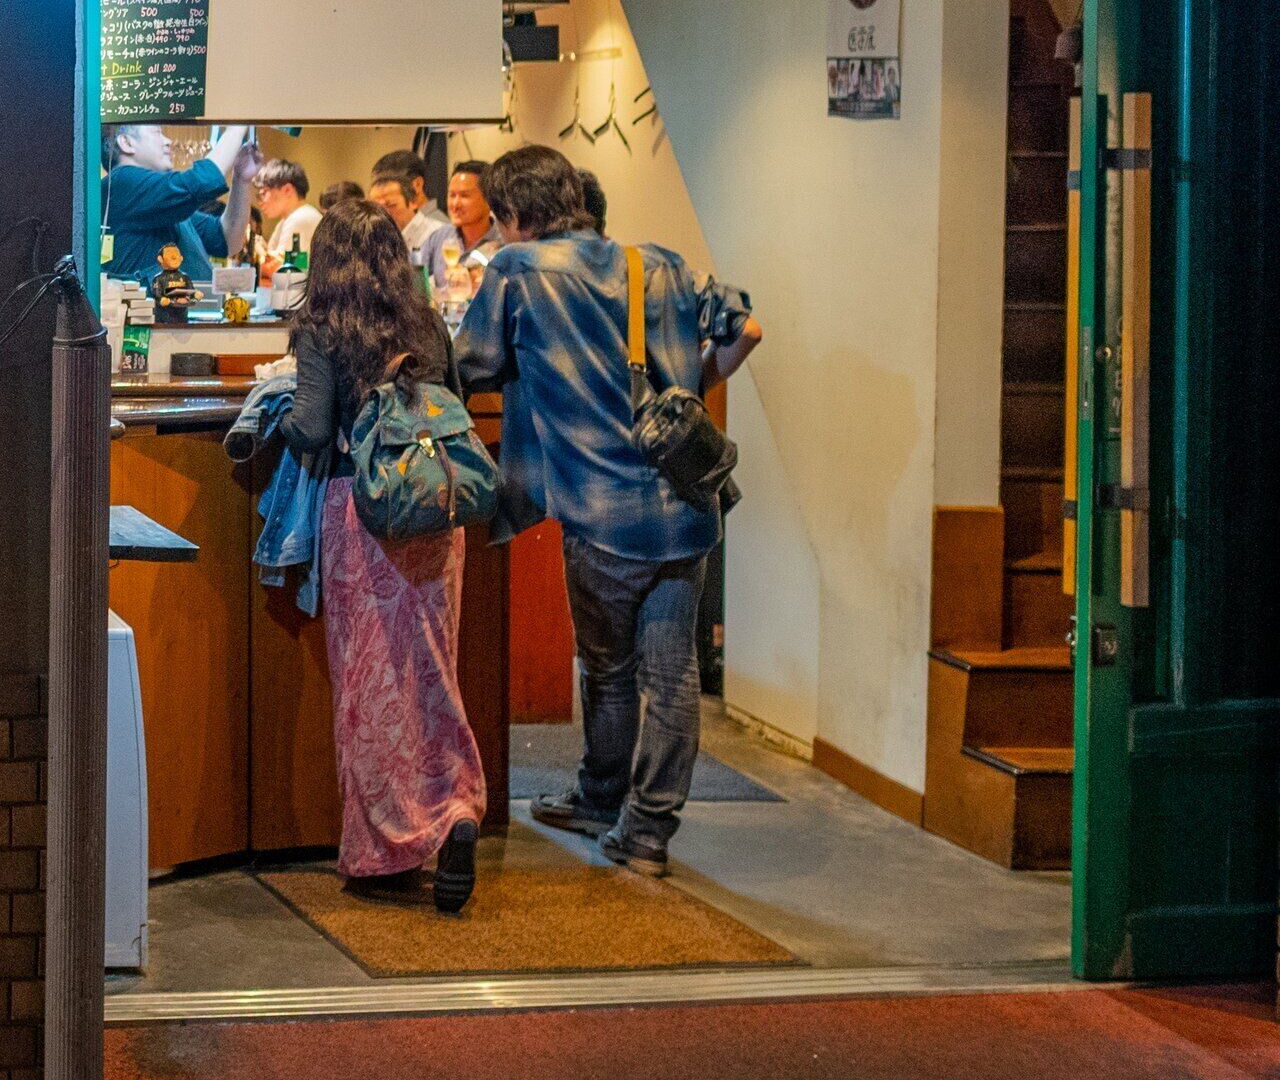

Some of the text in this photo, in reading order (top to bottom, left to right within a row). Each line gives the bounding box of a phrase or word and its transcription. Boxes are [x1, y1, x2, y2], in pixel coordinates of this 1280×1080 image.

[141, 6, 158, 18] 500
[111, 61, 142, 76] Drink
[169, 102, 186, 114] 250
